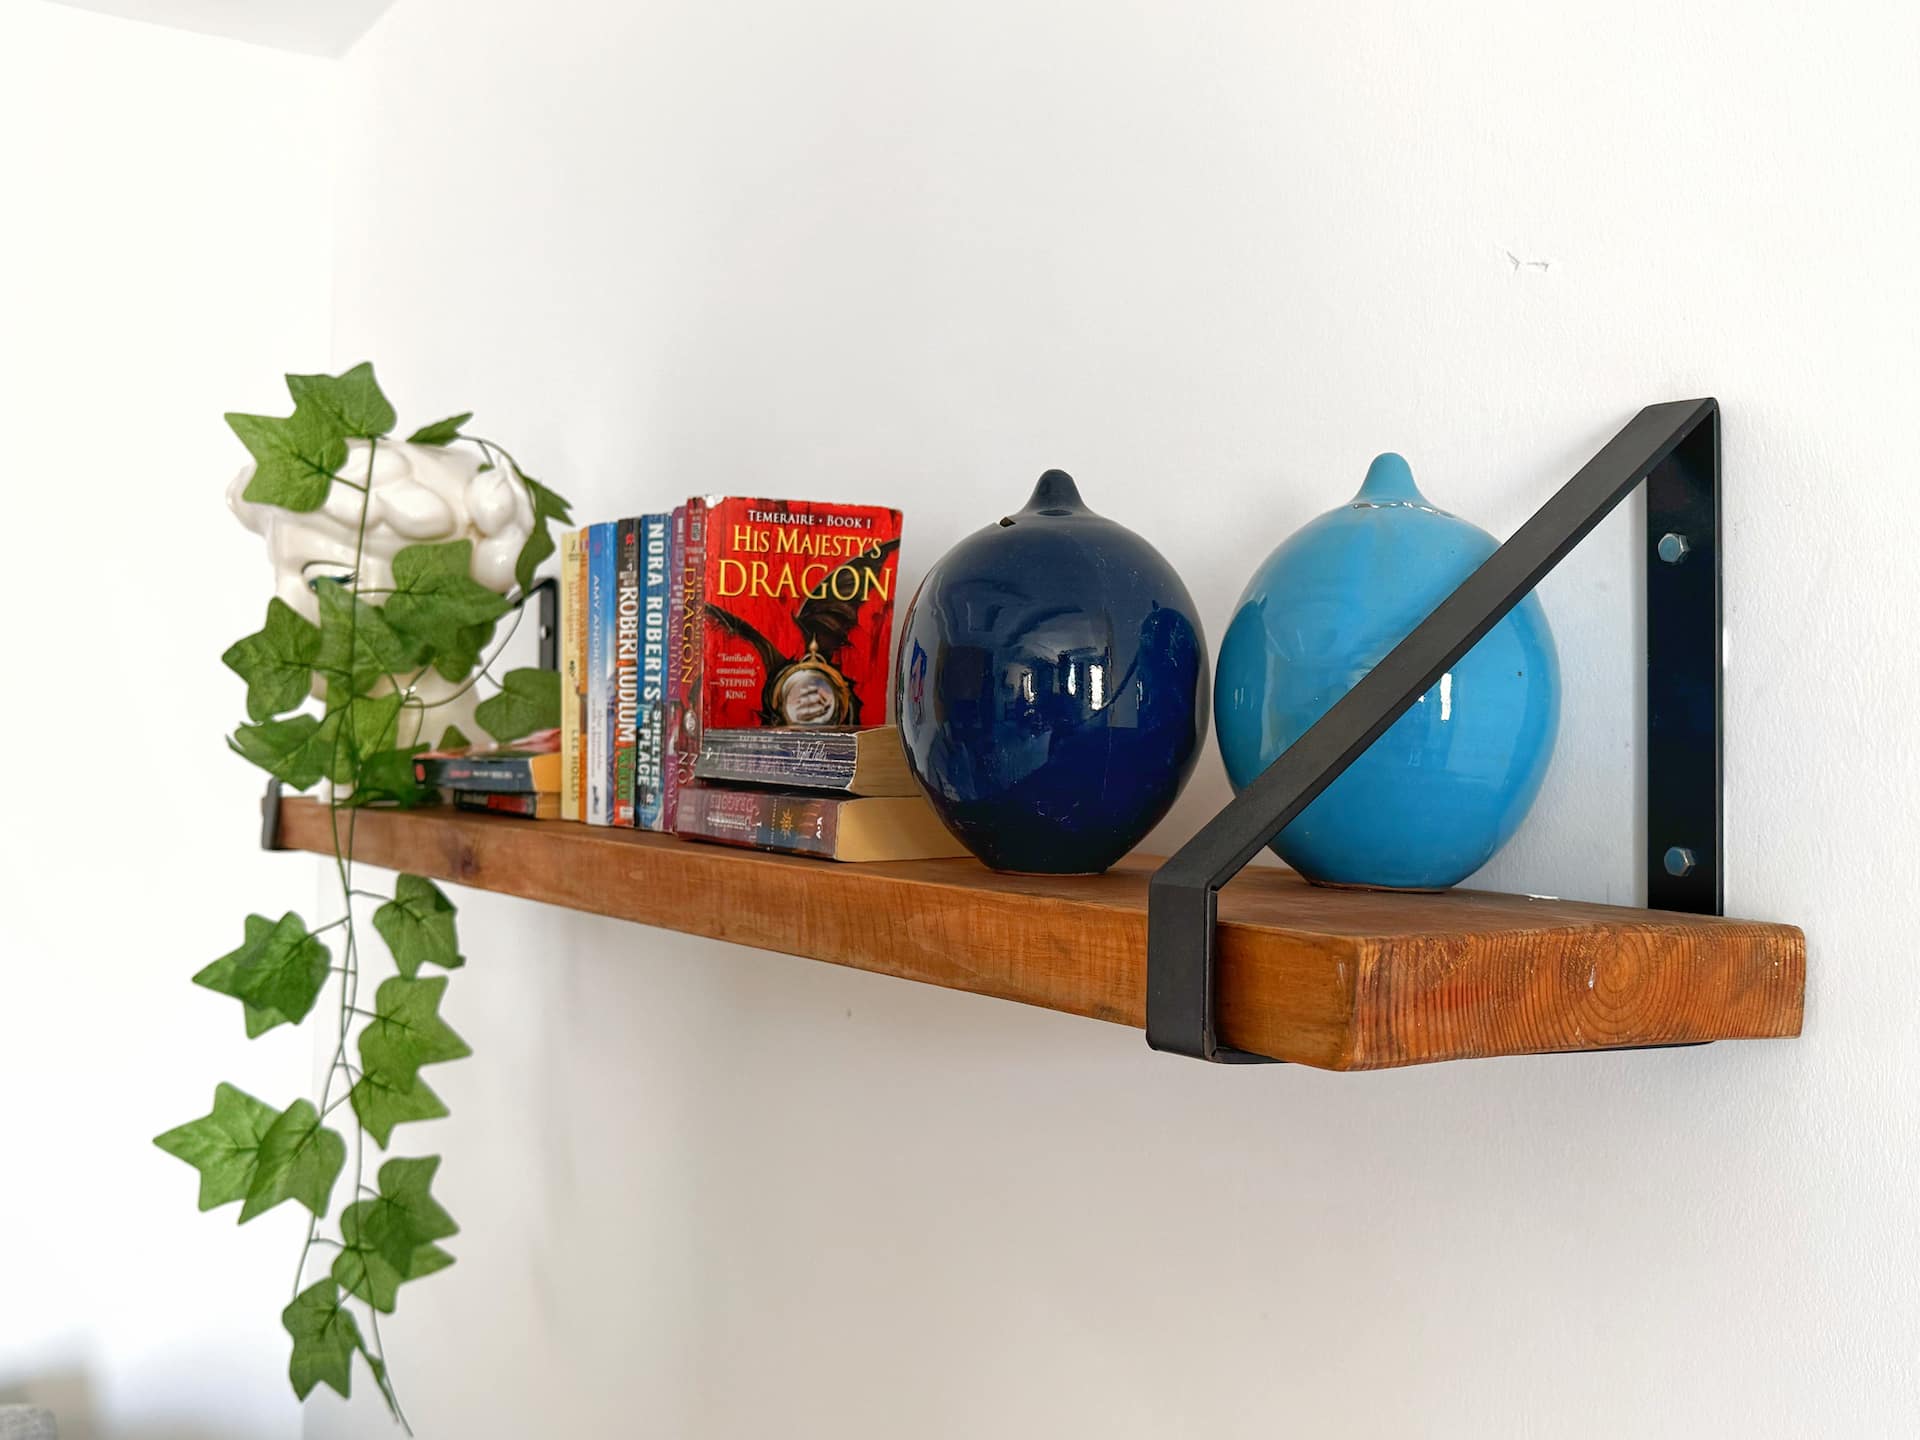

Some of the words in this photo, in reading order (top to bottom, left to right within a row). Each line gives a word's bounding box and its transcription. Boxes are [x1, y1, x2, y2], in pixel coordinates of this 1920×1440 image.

[733, 524, 770, 553] HIS
[777, 527, 882, 559] MAJESTY'S
[748, 510, 815, 525] TEMERAIRE
[827, 515, 862, 528] BOOK
[648, 523, 665, 586] NORA
[592, 575, 601, 608] AMY
[717, 559, 892, 601] DRAGON
[618, 586, 639, 660] ROBERT
[681, 567, 696, 683] DRAGON
[643, 596, 664, 700] ROBERTS
[617, 664, 638, 742] LUDLUM
[642, 708, 650, 723] IN
[725, 690, 746, 700] KING
[571, 729, 579, 752] LEE
[638, 728, 650, 786] PLACE
[650, 709, 662, 789] SHELTER
[570, 756, 580, 802] HOLLIS
